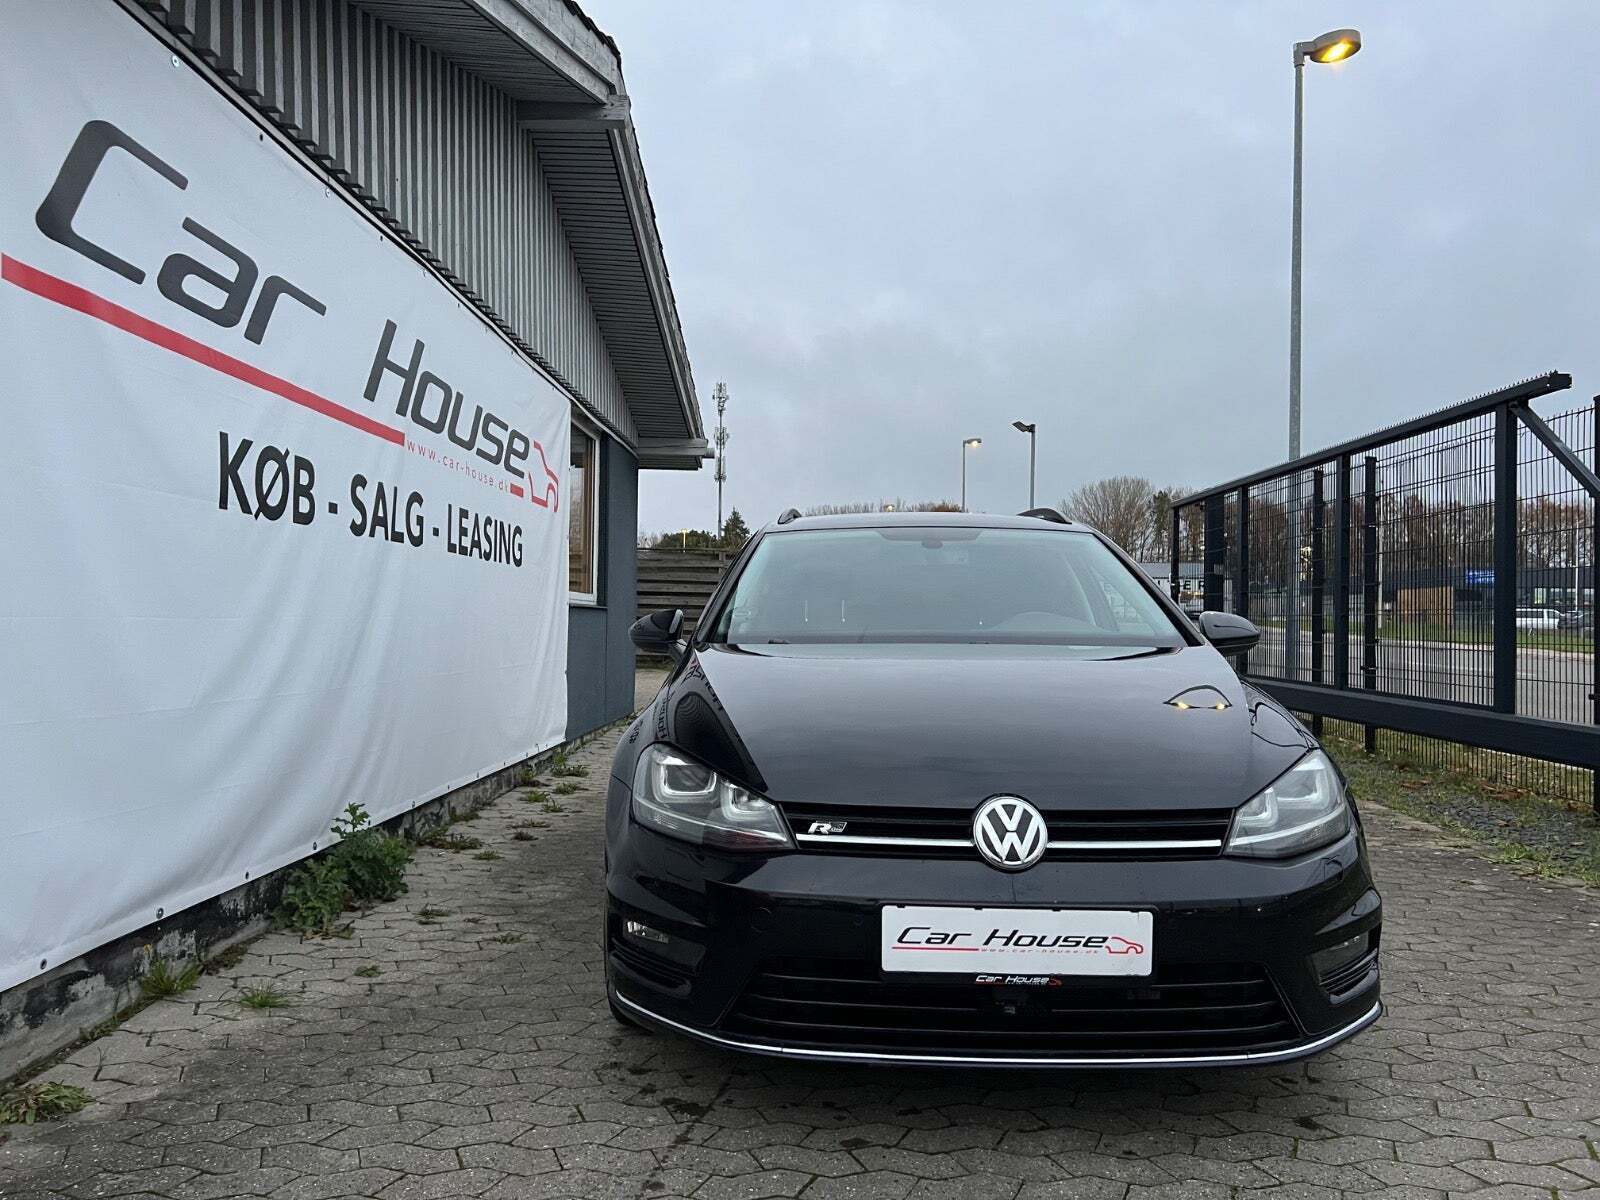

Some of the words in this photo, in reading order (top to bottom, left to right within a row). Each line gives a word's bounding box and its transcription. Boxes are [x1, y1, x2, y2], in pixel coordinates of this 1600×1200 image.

[35, 120, 327, 345] Car
[363, 319, 530, 479] House
[218, 431, 316, 526] KØB
[349, 473, 425, 548] SALG
[447, 503, 523, 567] LEASING
[897, 926, 972, 945] Car
[982, 929, 1109, 948] House
[975, 975, 1002, 983] Car
[1005, 975, 1050, 984] House
